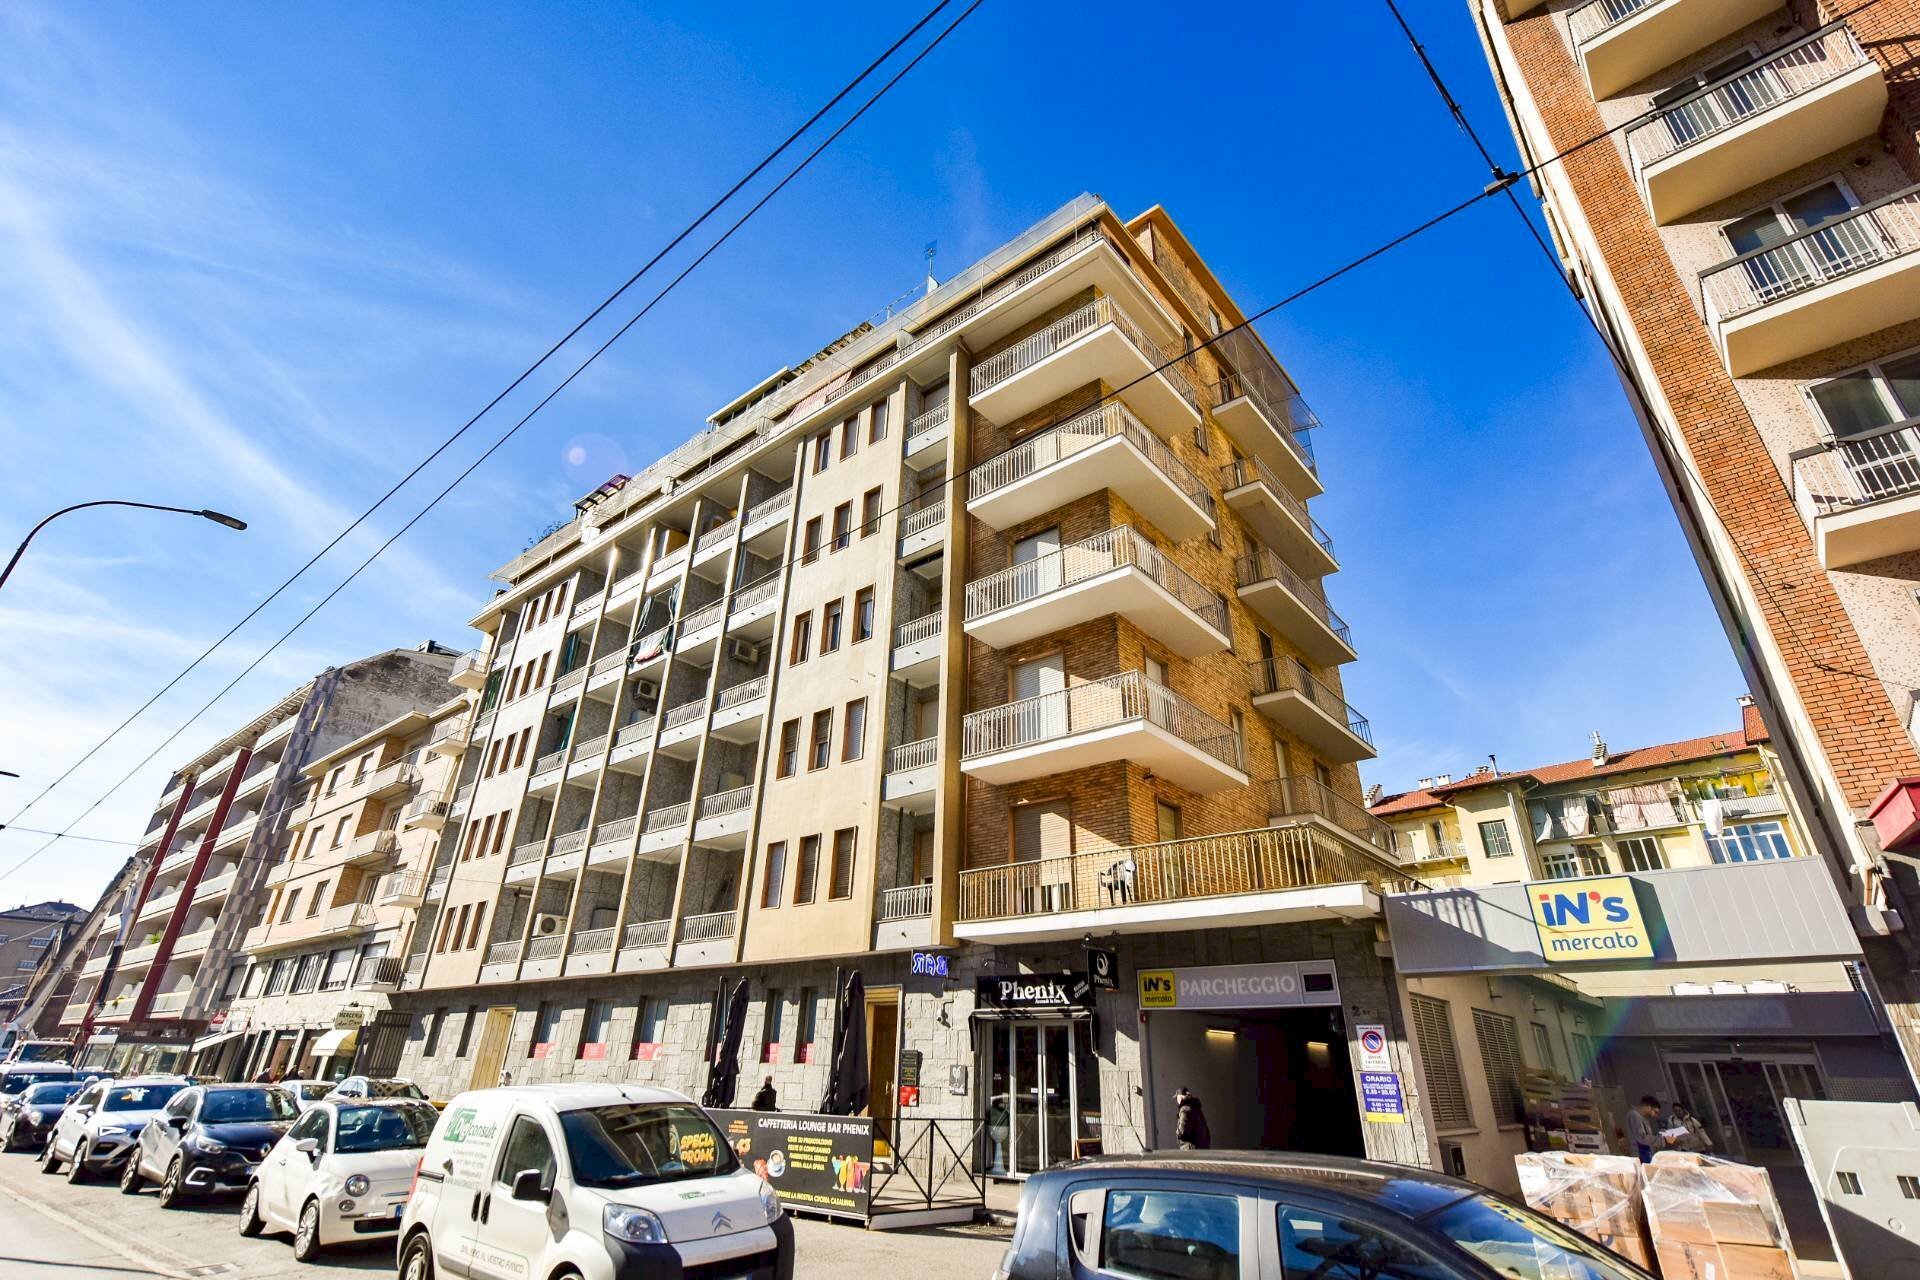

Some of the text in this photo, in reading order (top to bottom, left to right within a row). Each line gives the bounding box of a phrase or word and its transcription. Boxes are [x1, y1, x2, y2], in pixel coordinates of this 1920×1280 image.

[1551, 931, 1638, 951] mercato
[1000, 981, 1070, 1004] Phenix
[1180, 975, 1297, 996] PARCHEGGIO
[1365, 1075, 1392, 1083] ORARIO
[758, 1118, 797, 1130] CAFFETTERIA
[799, 1120, 826, 1132] LOUNGE
[827, 1122, 841, 1133] BAR
[842, 1123, 870, 1136] PHENIX
[681, 1133, 715, 1150] SPECIA
